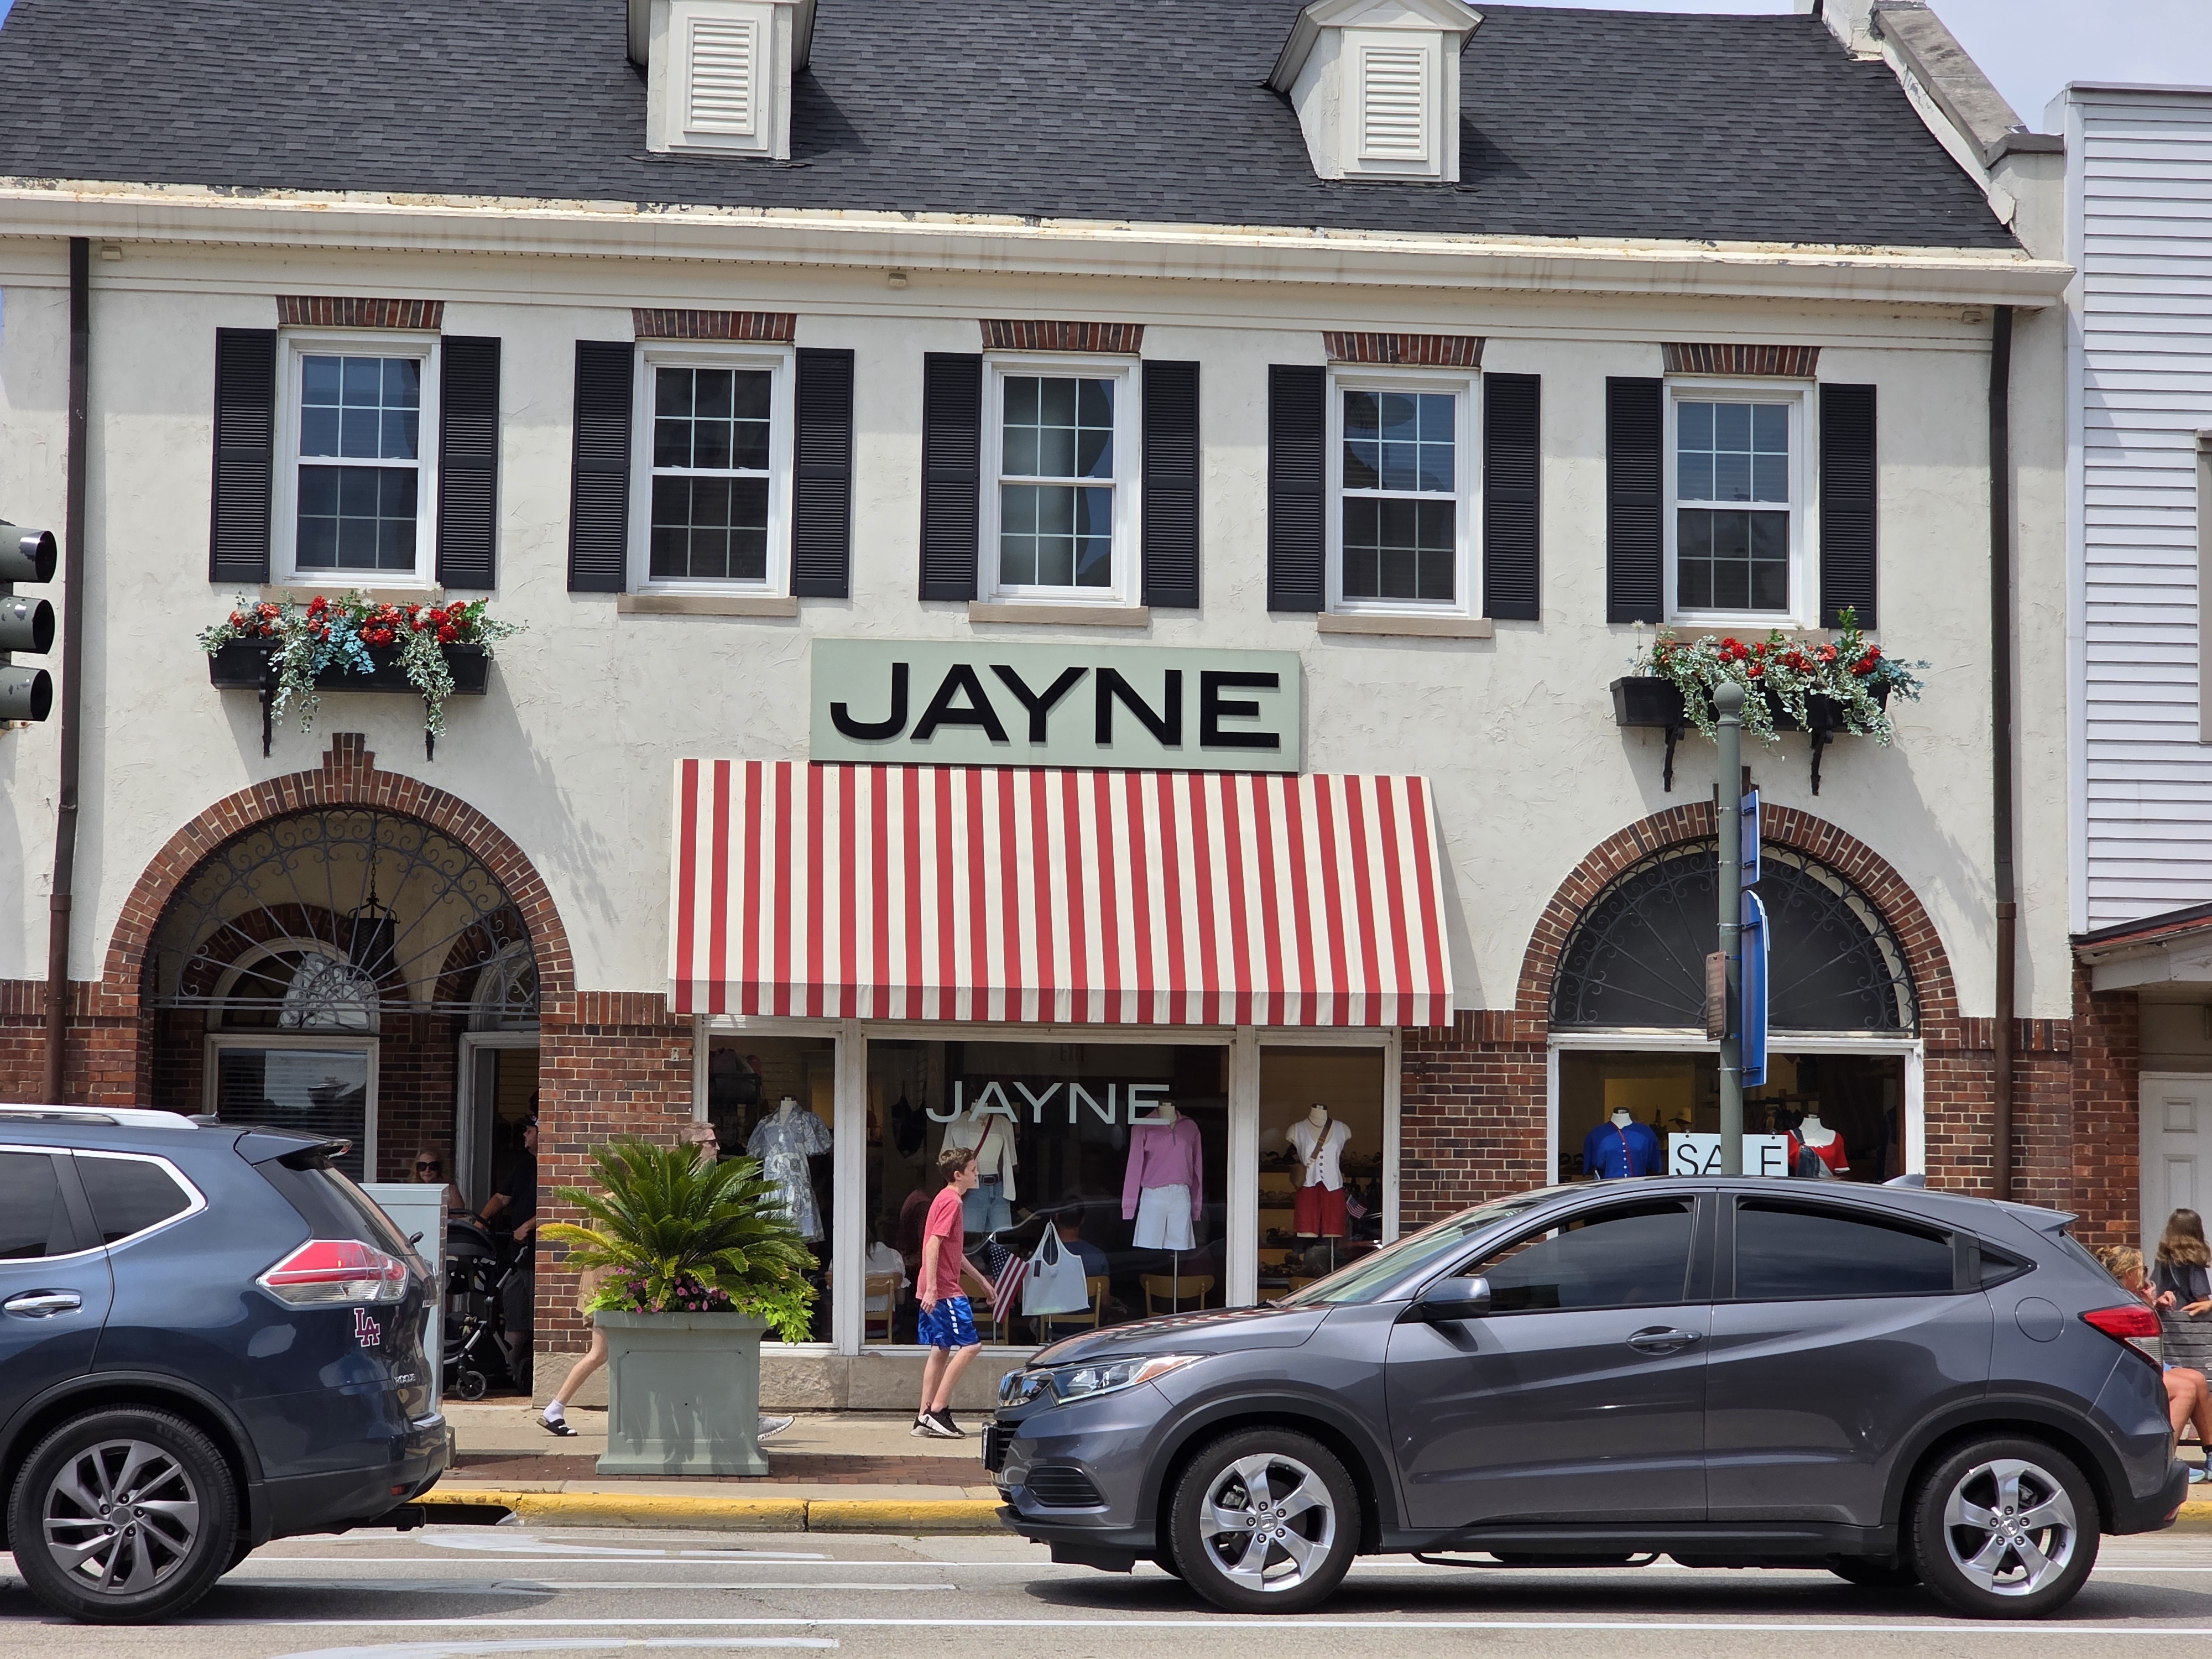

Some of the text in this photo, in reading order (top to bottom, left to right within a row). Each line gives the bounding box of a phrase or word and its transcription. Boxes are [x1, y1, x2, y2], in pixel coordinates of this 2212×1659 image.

[831, 662, 1279, 748] JAYNE
[926, 1081, 1170, 1125] JAYNE
[1676, 1144, 1782, 1176] SAE
[353, 1307, 380, 1348] LA
